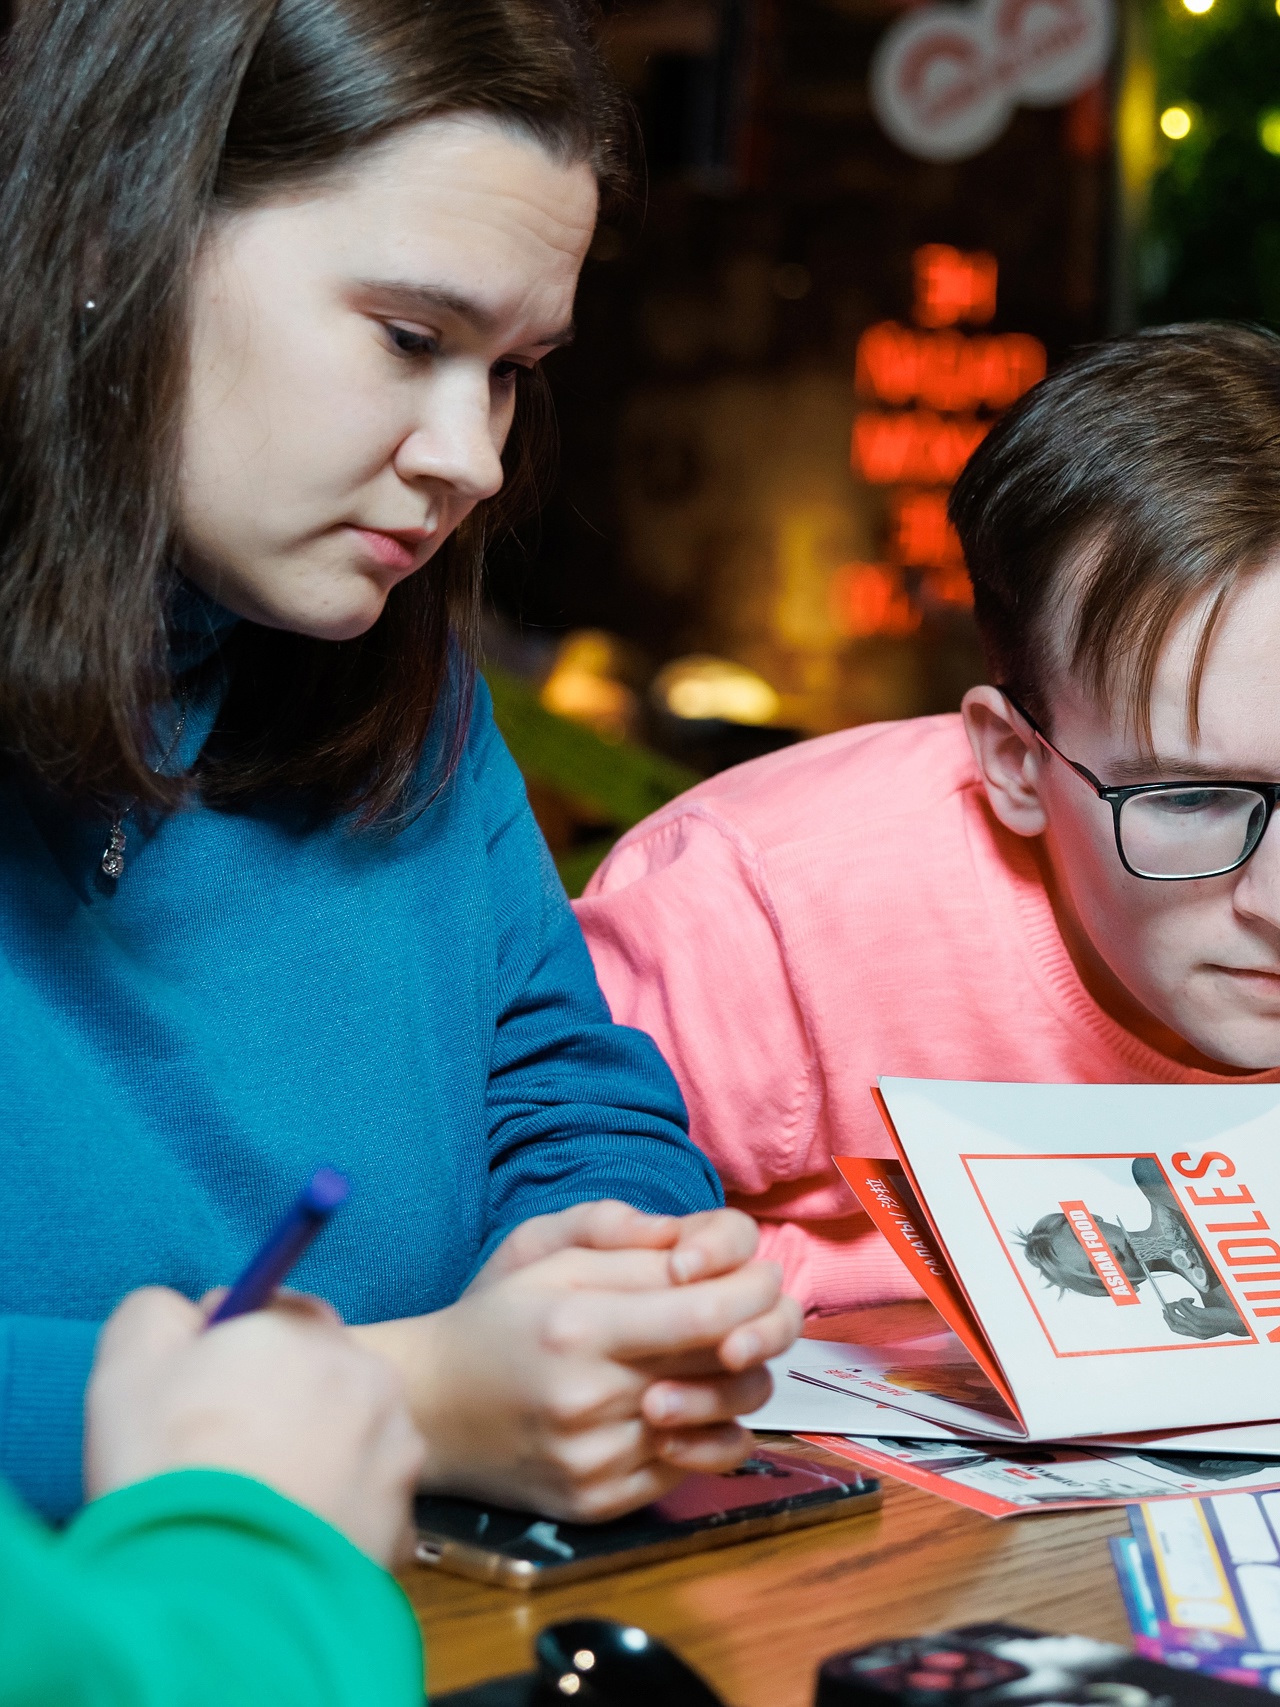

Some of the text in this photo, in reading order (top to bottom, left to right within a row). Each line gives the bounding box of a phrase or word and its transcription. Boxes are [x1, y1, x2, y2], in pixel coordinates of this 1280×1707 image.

[865, 1178, 900, 1209] 沙拉
[894, 1220, 946, 1276] САЛАТЫ
[1068, 1209, 1132, 1296] ASIAN FOOD
